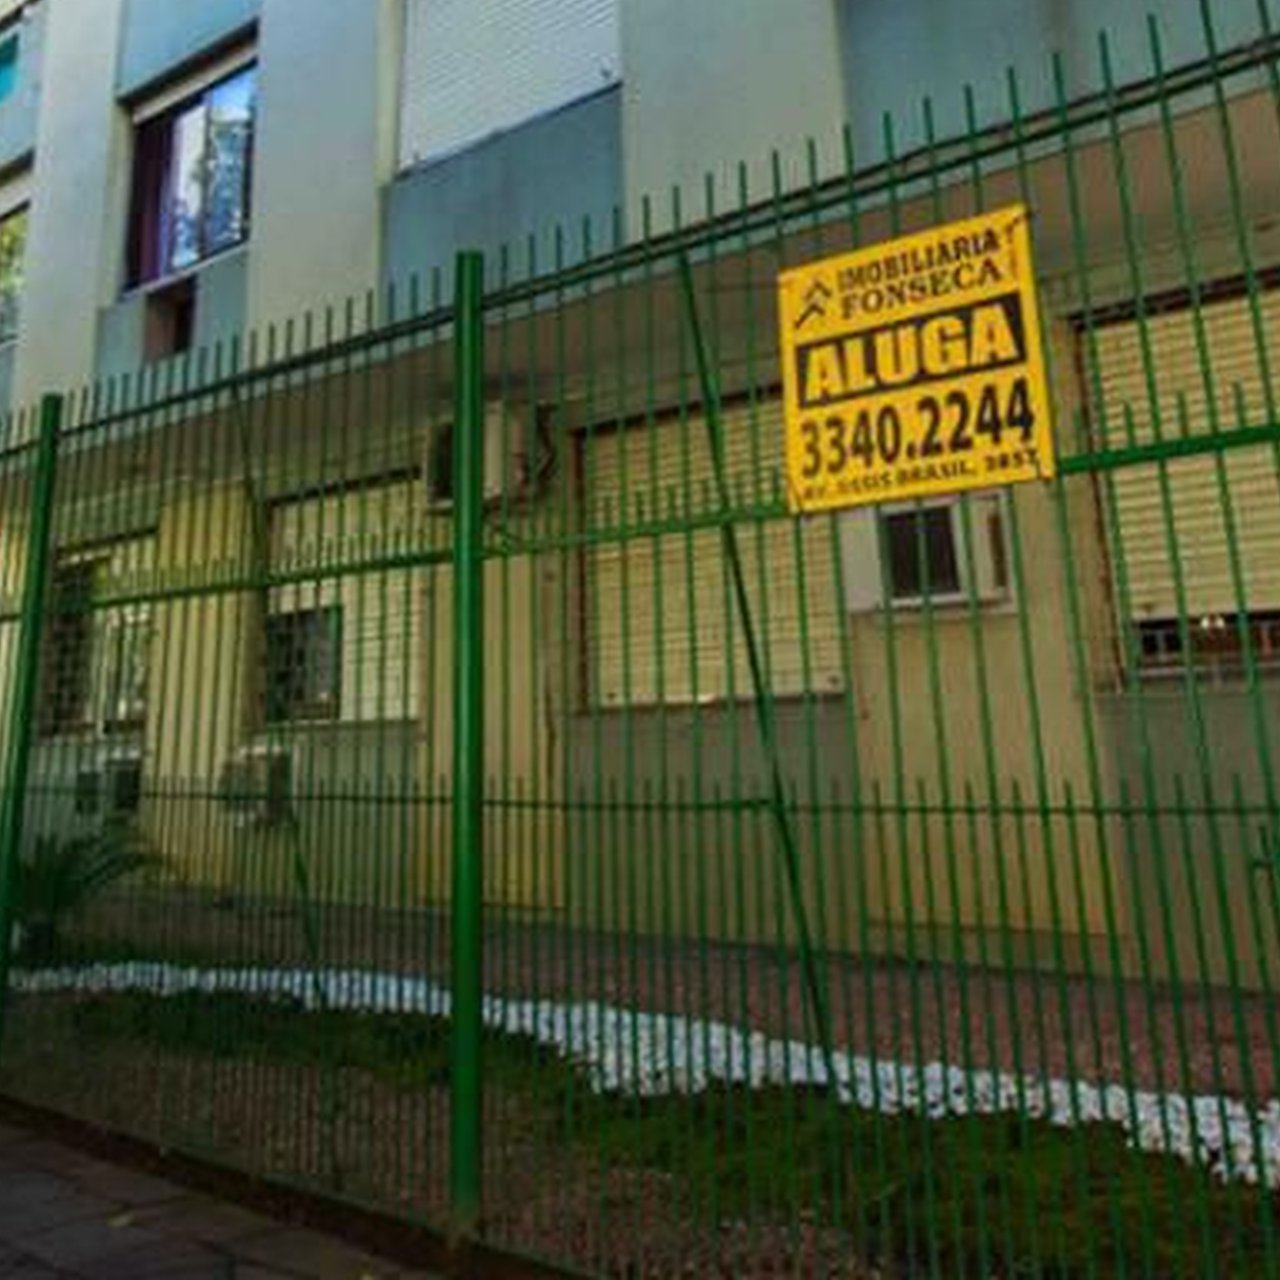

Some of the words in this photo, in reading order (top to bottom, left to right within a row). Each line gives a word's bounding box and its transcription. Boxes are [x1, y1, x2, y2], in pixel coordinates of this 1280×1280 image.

[837, 227, 1000, 291] IMOBILIARIA
[841, 258, 1001, 319] FONSECA
[804, 302, 1018, 403] ALUGA
[800, 376, 1034, 479] 3340.2244
